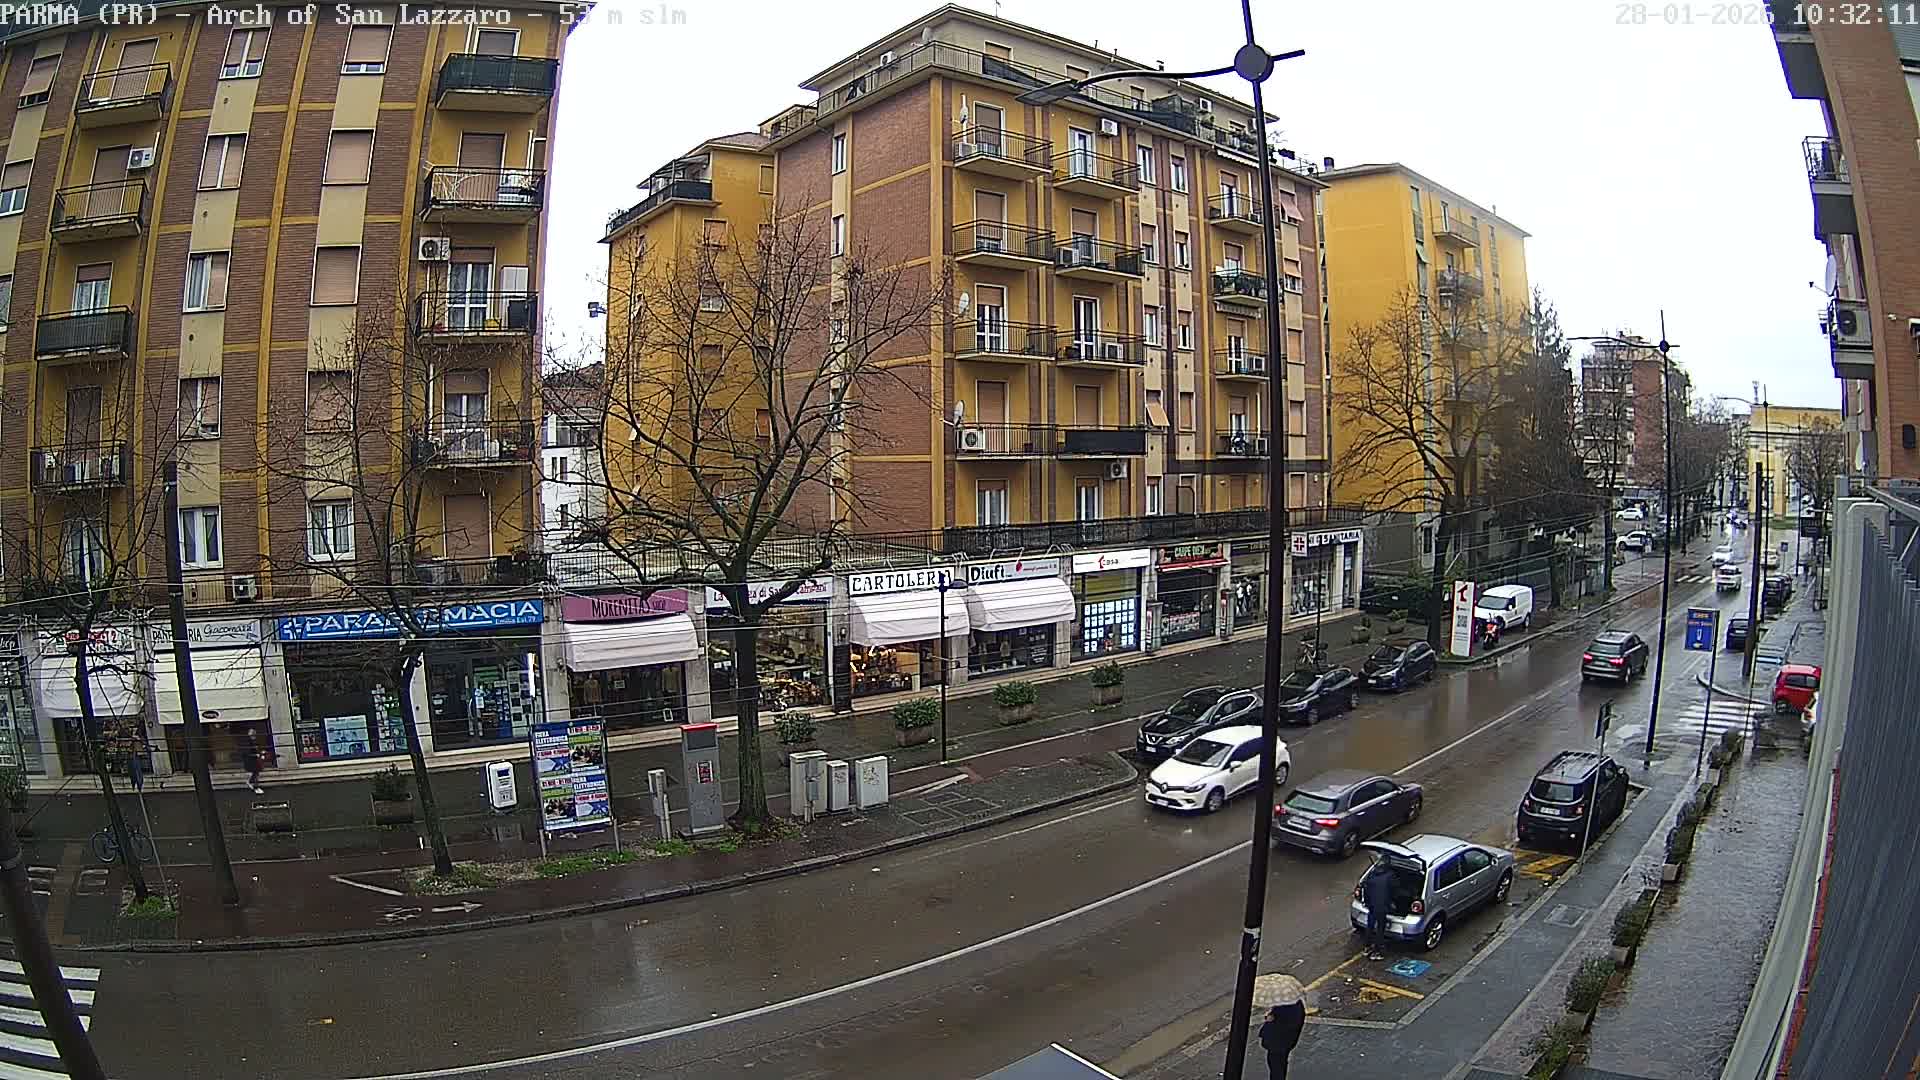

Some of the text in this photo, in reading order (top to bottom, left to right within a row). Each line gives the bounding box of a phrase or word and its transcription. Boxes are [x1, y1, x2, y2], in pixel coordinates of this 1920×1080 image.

[852, 569, 952, 592] CARTOLERA
[305, 601, 539, 632] PARAMACIA
[152, 628, 202, 643] PANRIA
